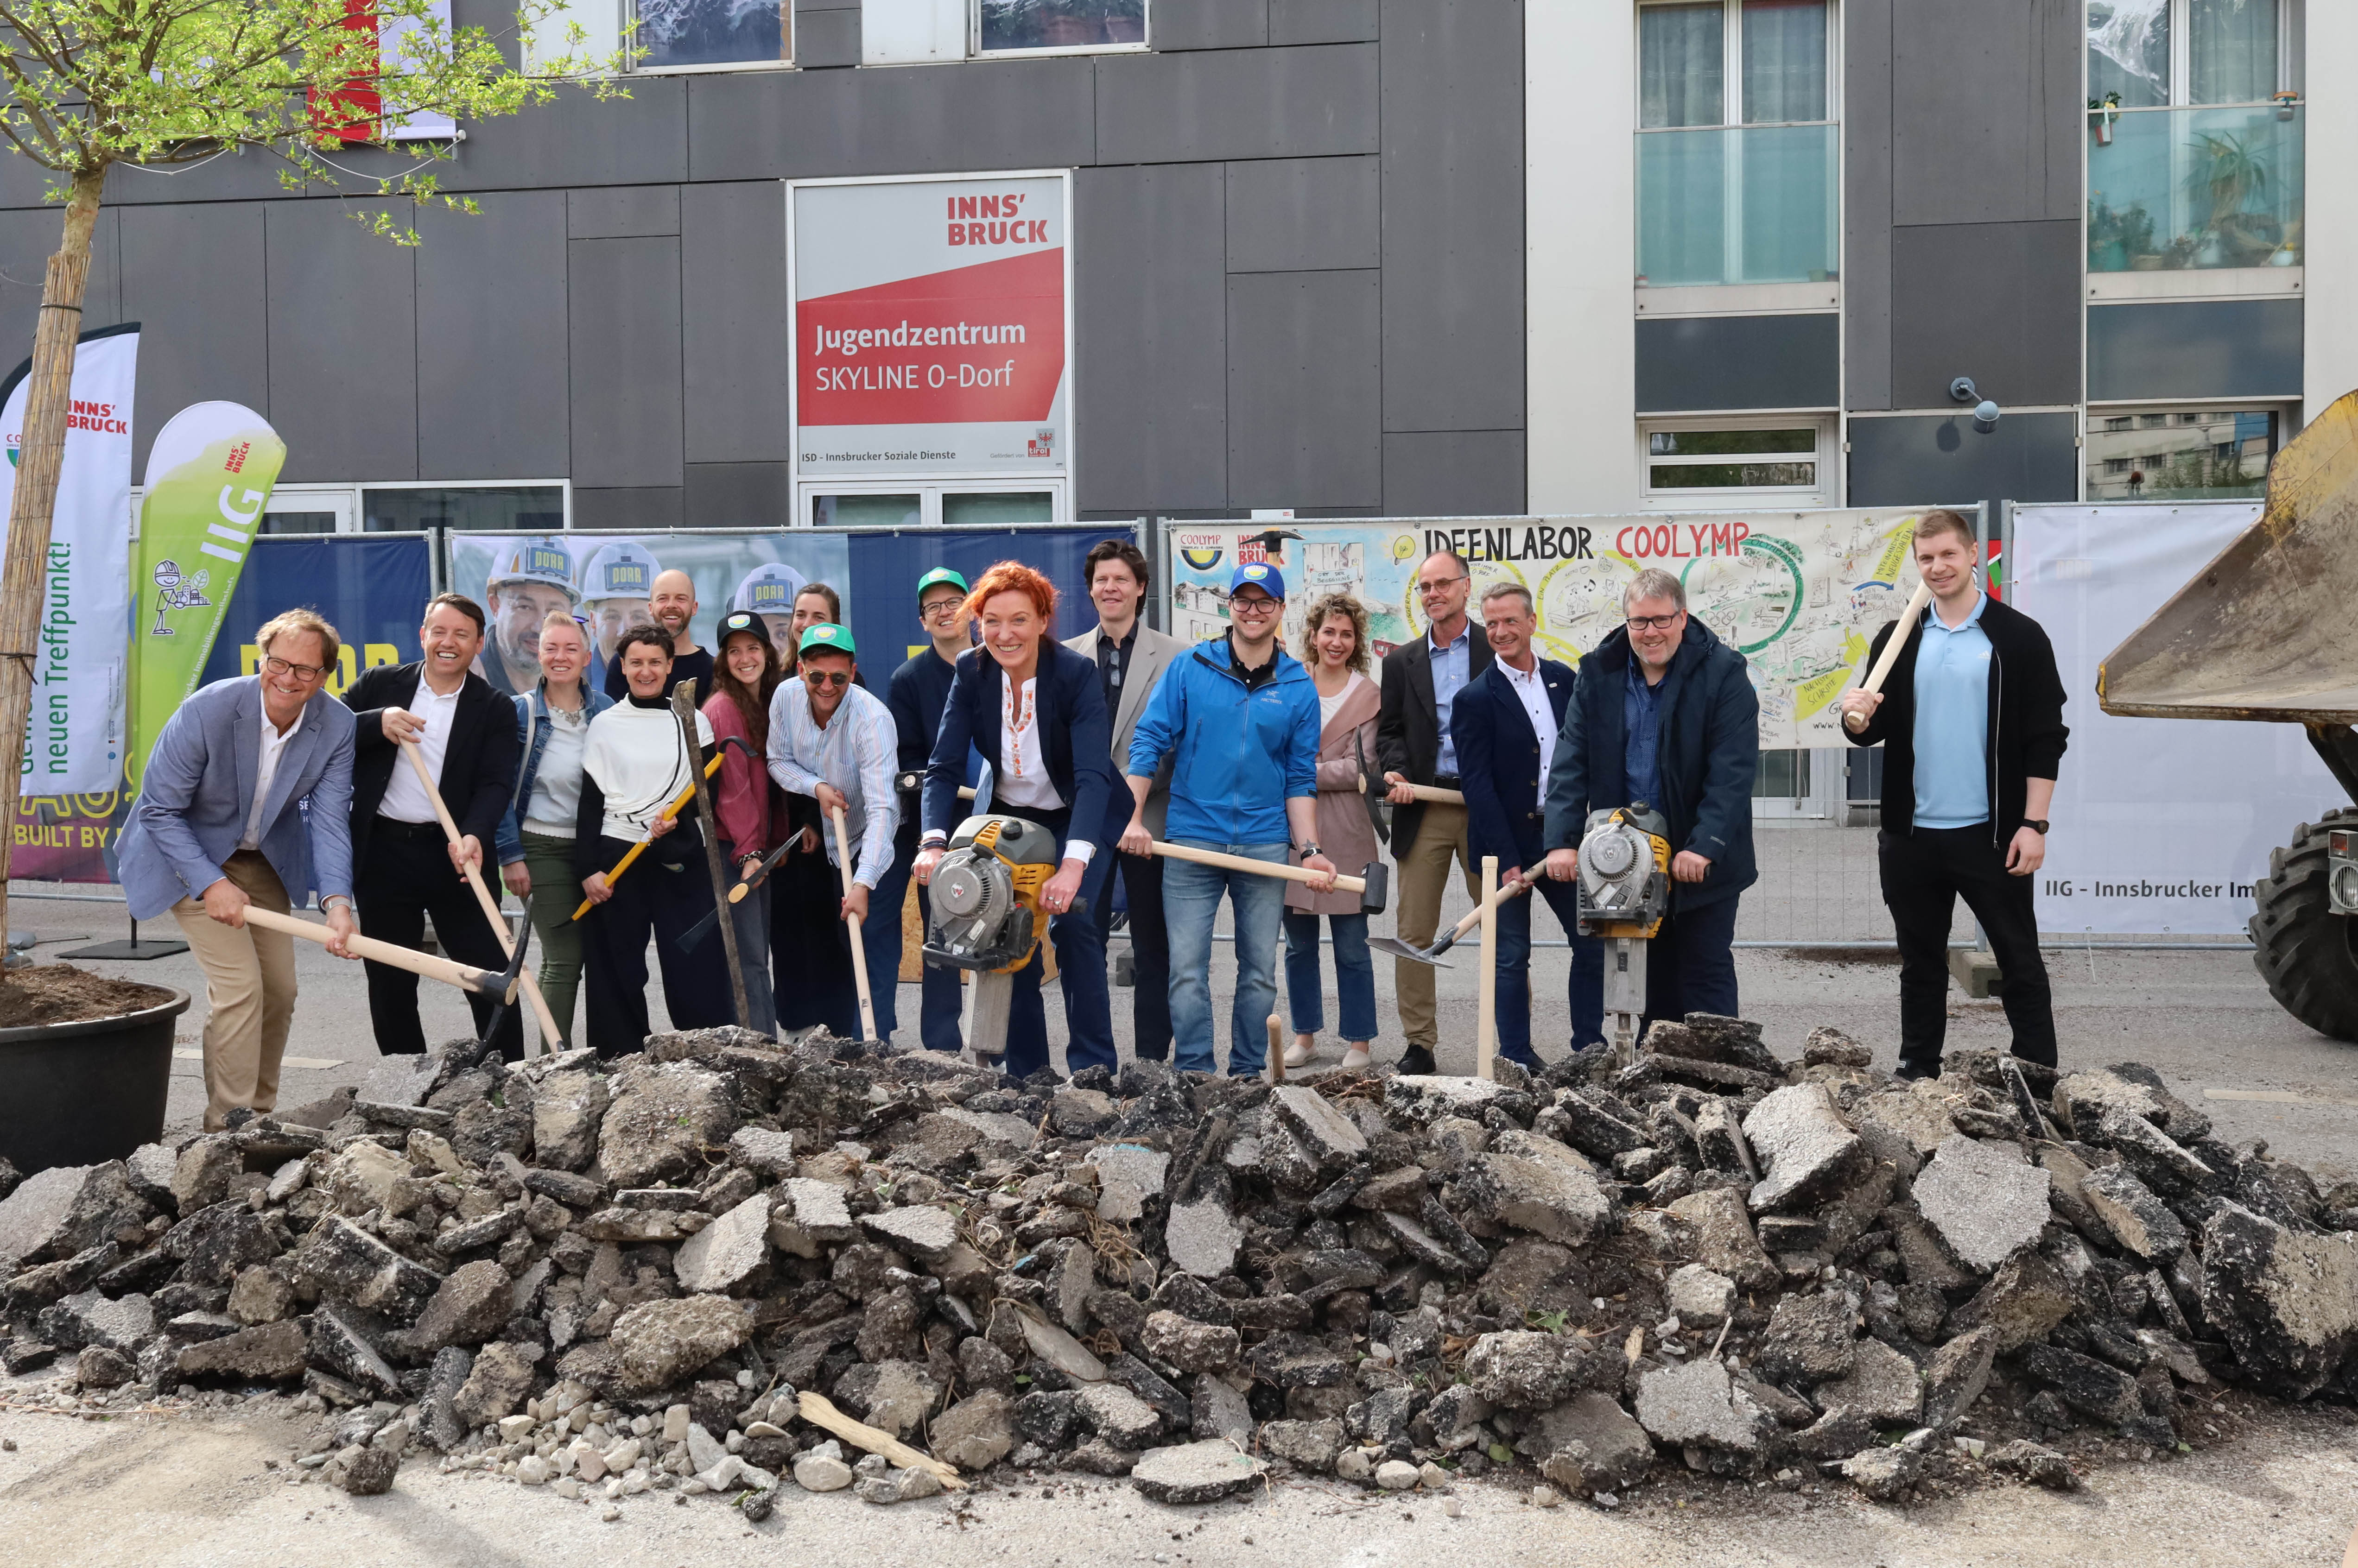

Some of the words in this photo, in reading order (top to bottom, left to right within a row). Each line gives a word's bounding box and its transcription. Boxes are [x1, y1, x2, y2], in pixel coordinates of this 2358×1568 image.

[948, 193, 1026, 220] INNS'
[948, 220, 1048, 246] BRUCK
[815, 320, 1026, 356] Jugendzentrum
[816, 365, 919, 391] SKYLINE
[927, 360, 1014, 388] O-Dorf
[67, 414, 127, 435] BRUCK
[232, 441, 251, 474] BRUCK
[802, 453, 817, 462] ISD
[825, 451, 882, 462] Innsbrucker
[884, 451, 918, 460] Soziale
[920, 450, 956, 460] Dienste
[199, 484, 265, 563] IIG
[1180, 534, 1221, 545] COOLYMP
[1424, 526, 1594, 561] IDEENLABOR
[1616, 522, 1749, 558] COOLYMP
[1876, 530, 1903, 575] MITEINANDER
[1886, 528, 1914, 577] NEUGESTALTEN
[535, 551, 564, 571] PORR
[1468, 563, 1498, 575] HNZIMMER
[1543, 564, 1561, 582] PLATZ
[1751, 539, 1803, 582] OLYMPIAPARK
[613, 567, 641, 584] PORR
[755, 585, 785, 600] PORR
[1405, 575, 1417, 628] LUGGERPLATZ
[43, 542, 77, 686] Treffpunkt!
[193, 576, 235, 672] Immobiliengesellschaft
[1807, 678, 1837, 705] SCHRITTE
[49, 695, 68, 774] neuen
[14, 824, 74, 847] BUILT
[80, 827, 109, 848] BY
[2046, 880, 2073, 897] IIG
[2095, 879, 2223, 898] Innsbrucker
